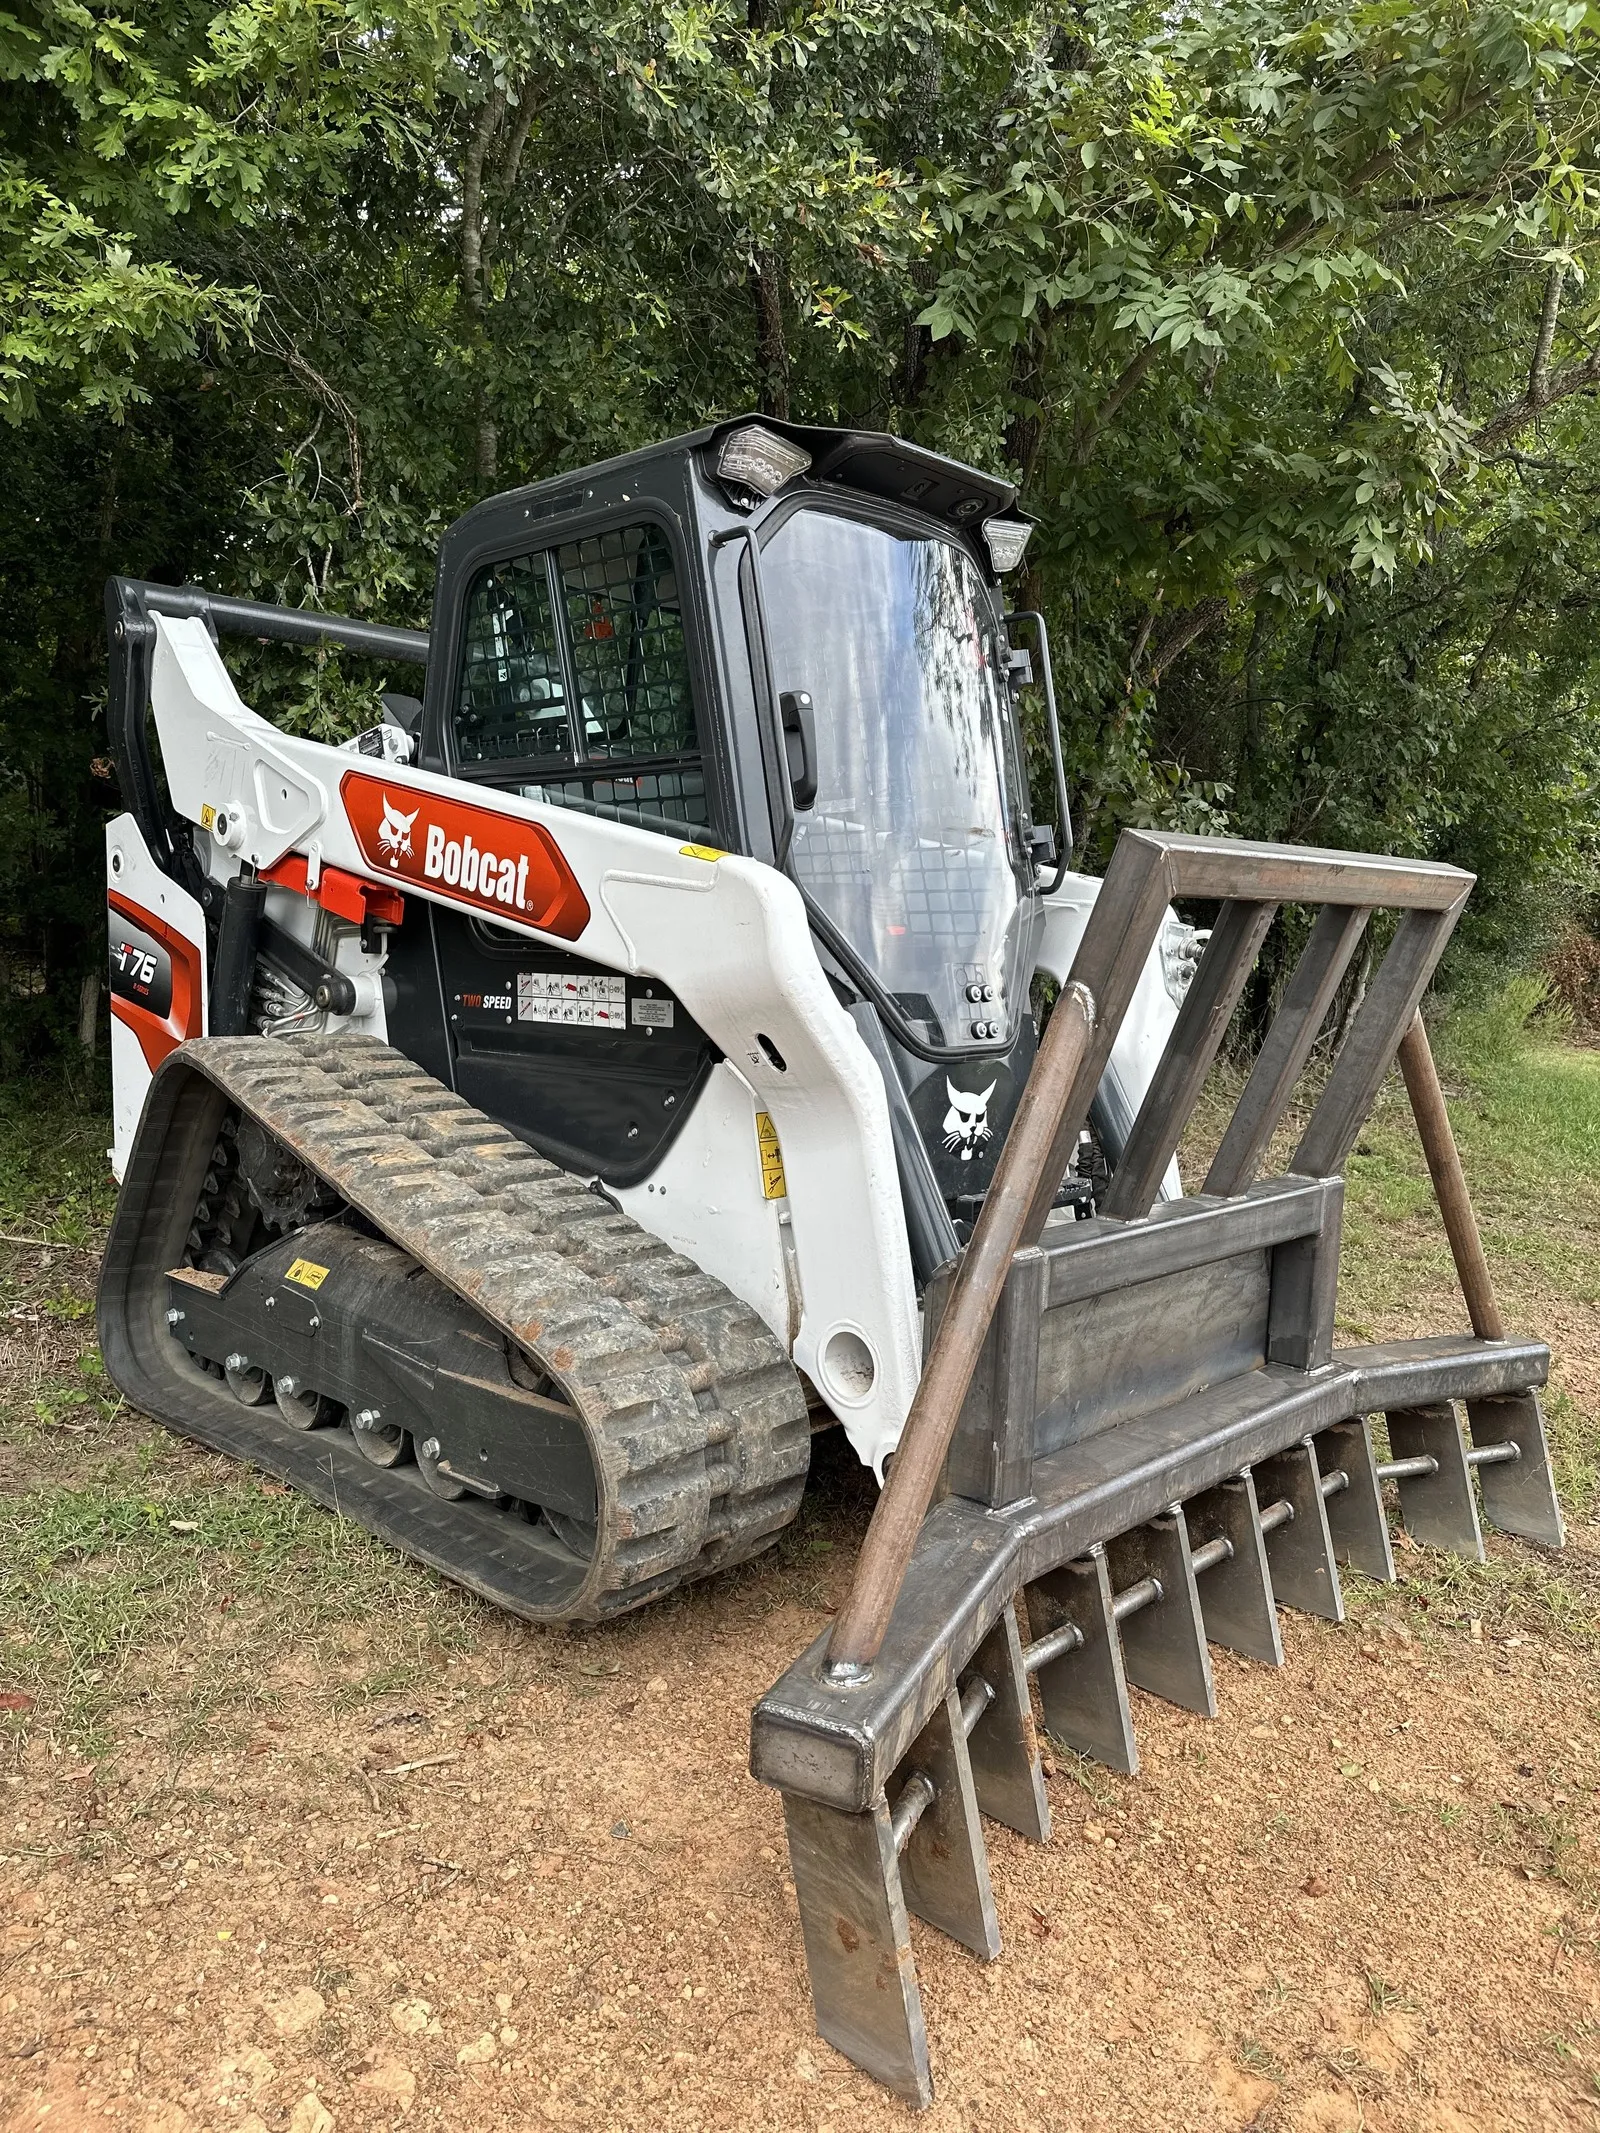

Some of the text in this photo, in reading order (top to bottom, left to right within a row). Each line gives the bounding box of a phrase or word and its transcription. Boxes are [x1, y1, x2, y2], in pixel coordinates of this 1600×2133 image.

[424, 823, 530, 910] Bobcat
[462, 994, 512, 1010] TWO SPEED
